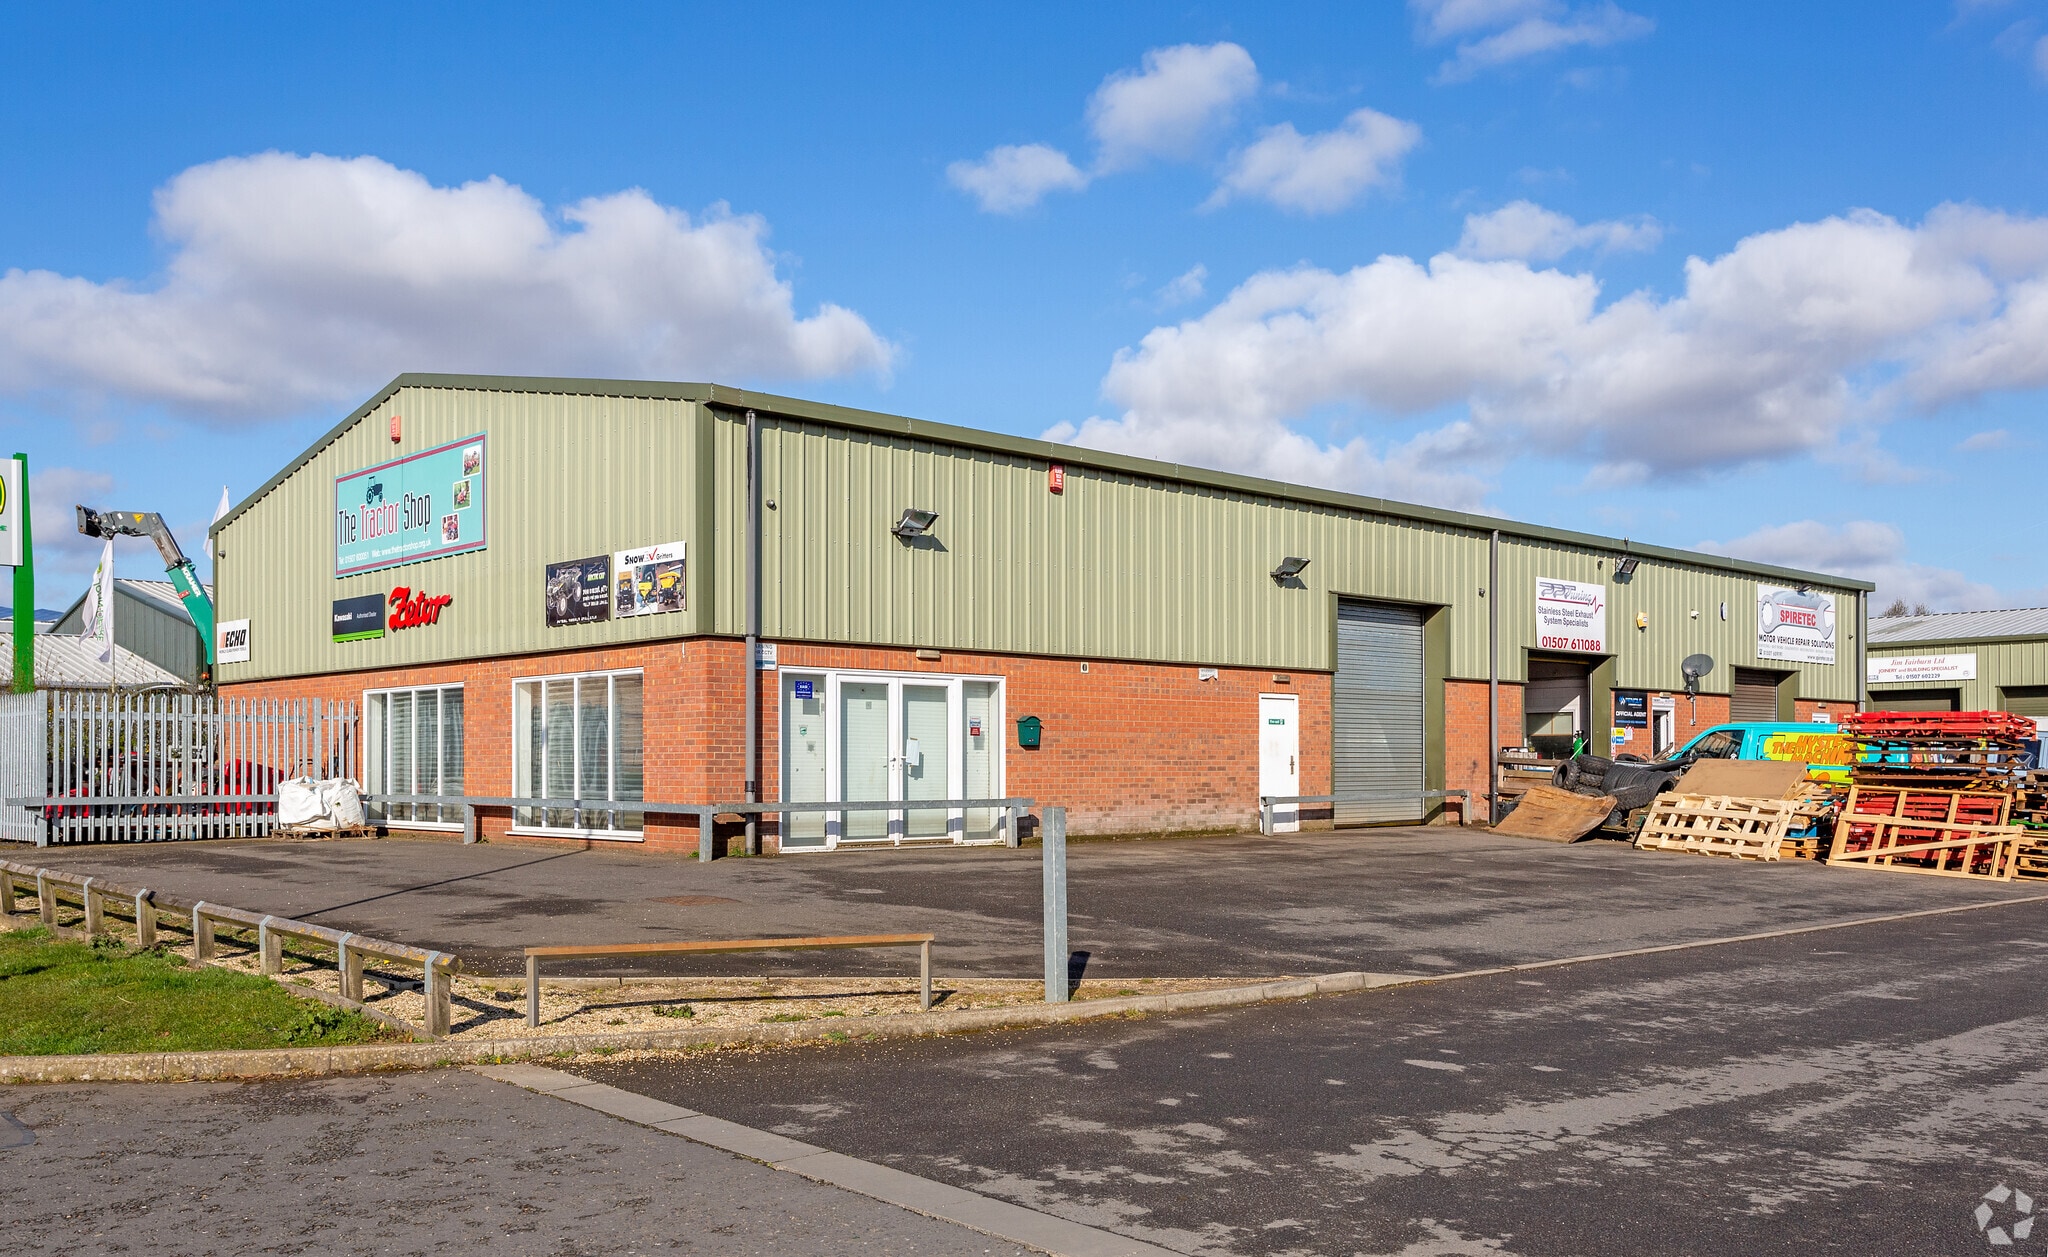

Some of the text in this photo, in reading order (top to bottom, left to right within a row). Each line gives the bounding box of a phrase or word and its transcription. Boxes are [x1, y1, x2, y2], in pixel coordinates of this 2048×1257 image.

[338, 492, 431, 545] The Tractor Shop
[182, 566, 201, 597] KRAMER
[388, 585, 451, 630] Zetor
[1537, 605, 1594, 619] Stainless Steel Exhaust
[1543, 615, 1589, 627] System Specialists
[1780, 609, 1816, 626] SPIRETEC
[225, 629, 247, 648] ECHO
[1542, 636, 1601, 651] 01507 611088
[1758, 634, 1776, 643] MOTOR
[1777, 635, 1795, 645] VEHICLE
[1795, 637, 1810, 646] REPAIR
[1811, 639, 1835, 650] SOLUTIONS
[1904, 658, 1932, 666] Fairburn
[1933, 657, 1946, 665] Ltd
[1772, 741, 1797, 754] THE
[1796, 735, 1853, 753] MYSTE
